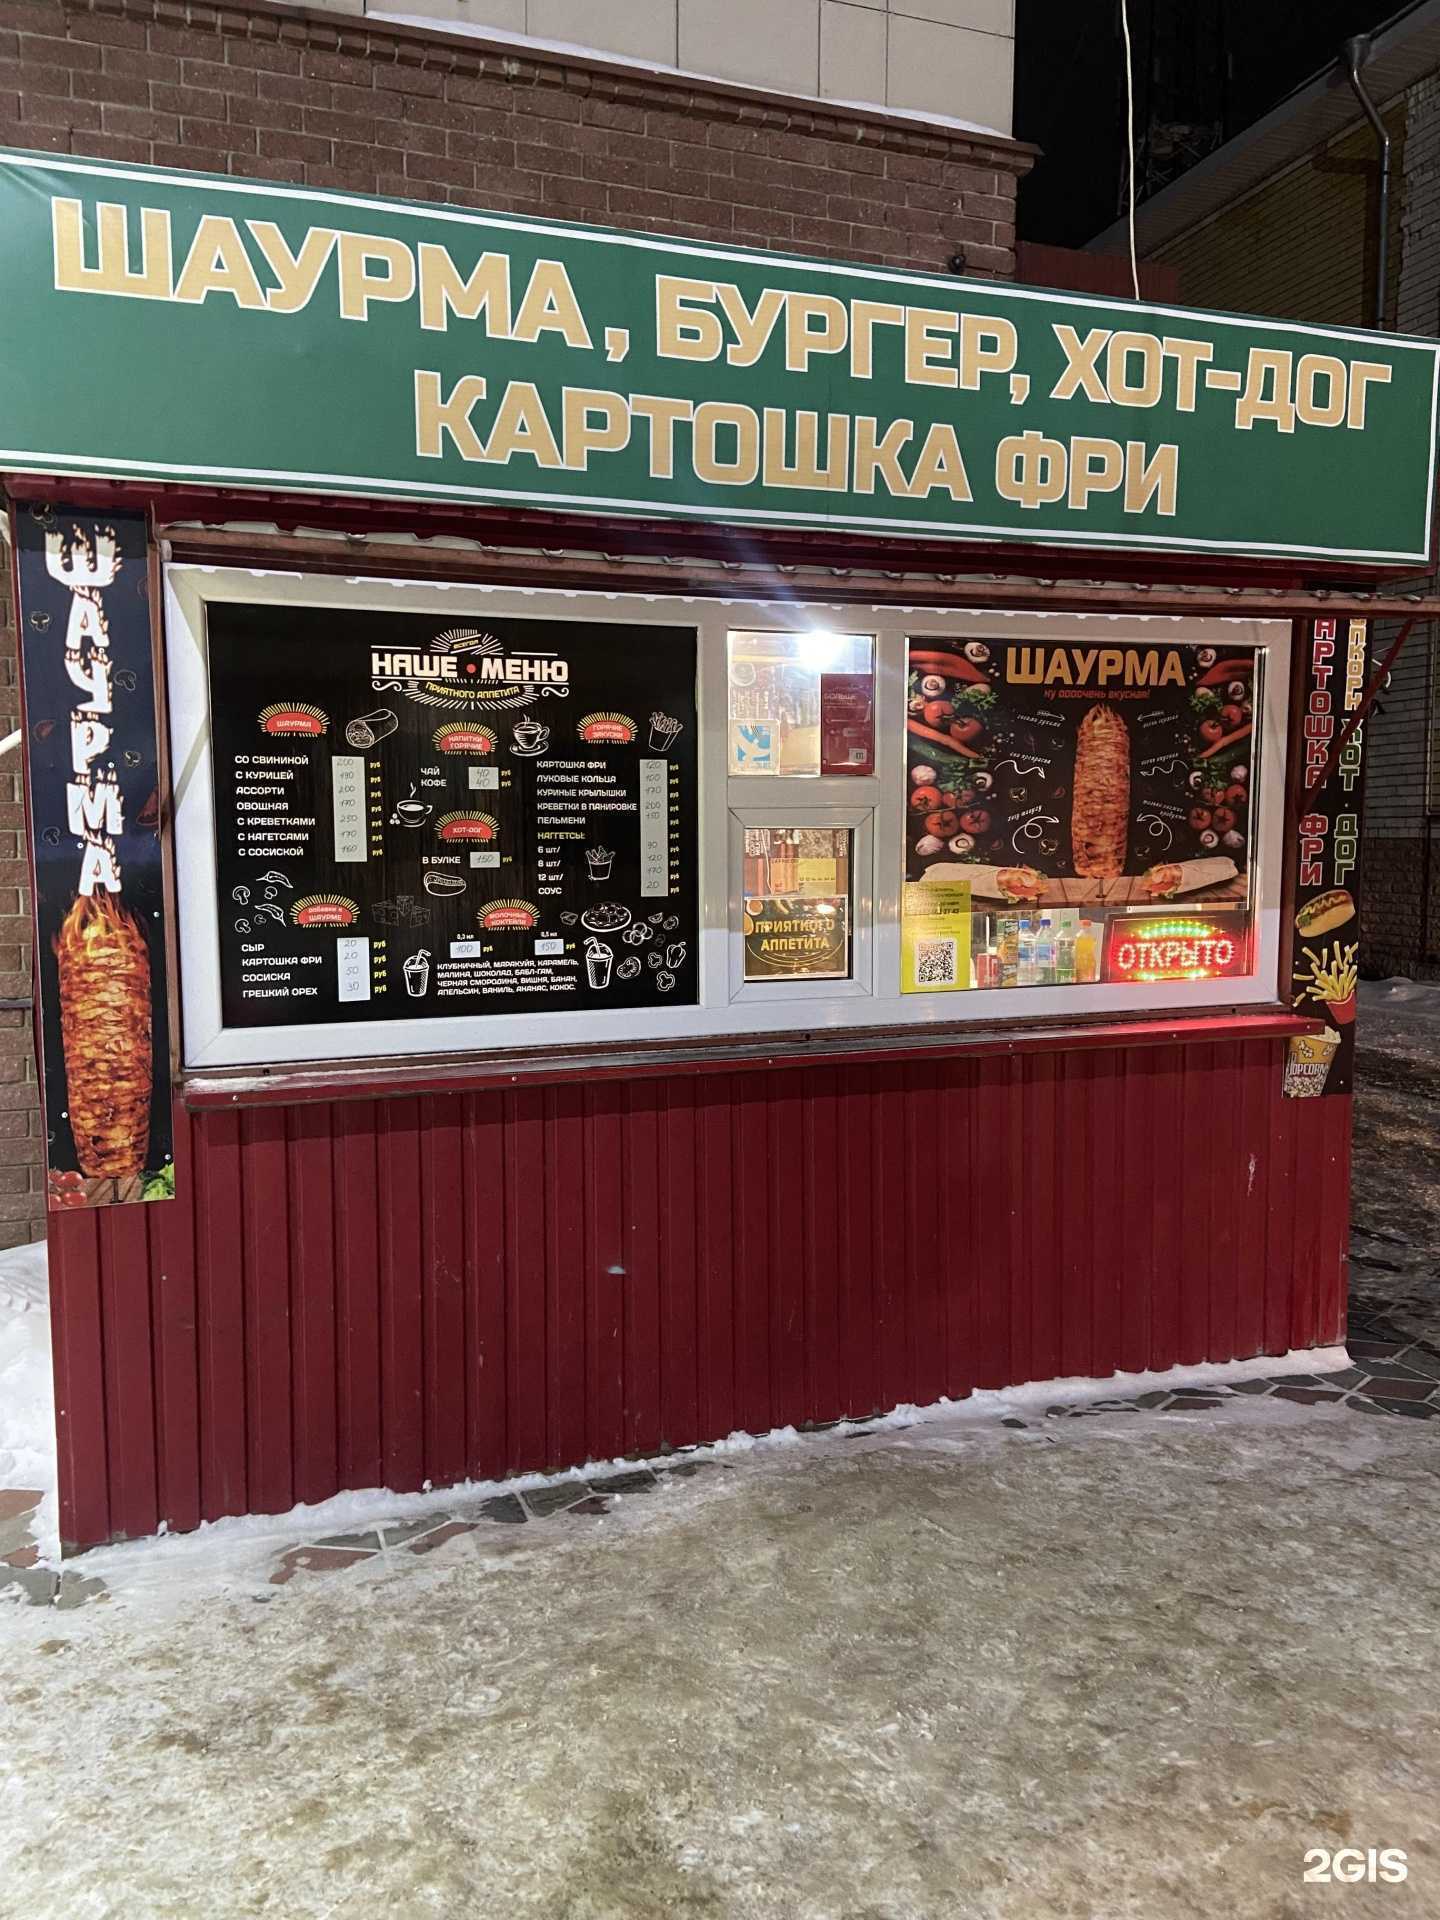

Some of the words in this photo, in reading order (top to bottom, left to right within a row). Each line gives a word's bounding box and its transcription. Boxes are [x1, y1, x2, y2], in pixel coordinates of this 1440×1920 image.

[51, 195, 630, 362] ШАУРМА,
[655, 273, 1031, 405] БУРГЕР,
[1049, 323, 1393, 434] ХОТ-ДОГ
[413, 369, 974, 503] КАРТОШКА
[995, 430, 1180, 517] ФРИ
[371, 653, 458, 677] НАШЕ
[480, 657, 569, 682] МЕНЮ
[1006, 646, 1186, 687] ШАУРМА
[425, 681, 475, 699] ПРИЯТНОГО
[476, 685, 520, 699] АППЕТИТА
[45, 522, 124, 897] ШАУРМА
[234, 755, 250, 764] СО
[251, 755, 309, 765] СВИНИНОЙ
[536, 760, 585, 769] КАРТОШКА
[587, 761, 606, 769] ФРИ
[235, 771, 244, 780] С
[245, 770, 294, 780] КУРИЦЕЙ
[420, 766, 441, 776] ЧАЙ
[420, 779, 447, 787] КОФЕ
[536, 775, 579, 783] ЛУКОВЫЕ
[581, 775, 616, 784] КОЛЬЦА
[235, 786, 285, 796] АССОРТИ
[536, 788, 577, 797] КУРИНЫЕ
[578, 789, 626, 797] КРЫЛЫШКИ
[537, 803, 580, 811] КРЕВЕТКИ
[581, 803, 587, 811] В
[588, 803, 637, 811] ПАНИРОВКЕ
[237, 817, 245, 826] С
[247, 817, 316, 826] КРЕВЕТКАМИ
[537, 816, 586, 825] ПЕЛЬМЕНИ
[237, 833, 246, 841] С
[247, 832, 309, 841] НАГЕТСАМИ
[238, 848, 246, 857] С
[248, 846, 304, 857] СОСИСКОЙ
[1299, 813, 1328, 886] ФРИ
[1333, 813, 1358, 885] ДОГ
[422, 856, 429, 864] В
[431, 856, 461, 864] БУЛКЕ
[538, 873, 547, 881] 12
[538, 887, 562, 895] СОУС
[755, 918, 835, 933] ПРИЯТНОГО
[241, 943, 265, 952] СЫР
[760, 937, 830, 951] АППЕТИТА
[1118, 939, 1235, 970] ОТКРЫТО
[241, 956, 298, 967] КАРТОШКА
[300, 956, 323, 965] ФРИ
[242, 972, 291, 982] СОСИСКА
[437, 980, 468, 988] ЧЕРНАЯ
[242, 986, 289, 998] ГРЕЦКИЙ
[291, 987, 318, 996] ОРЕХ
